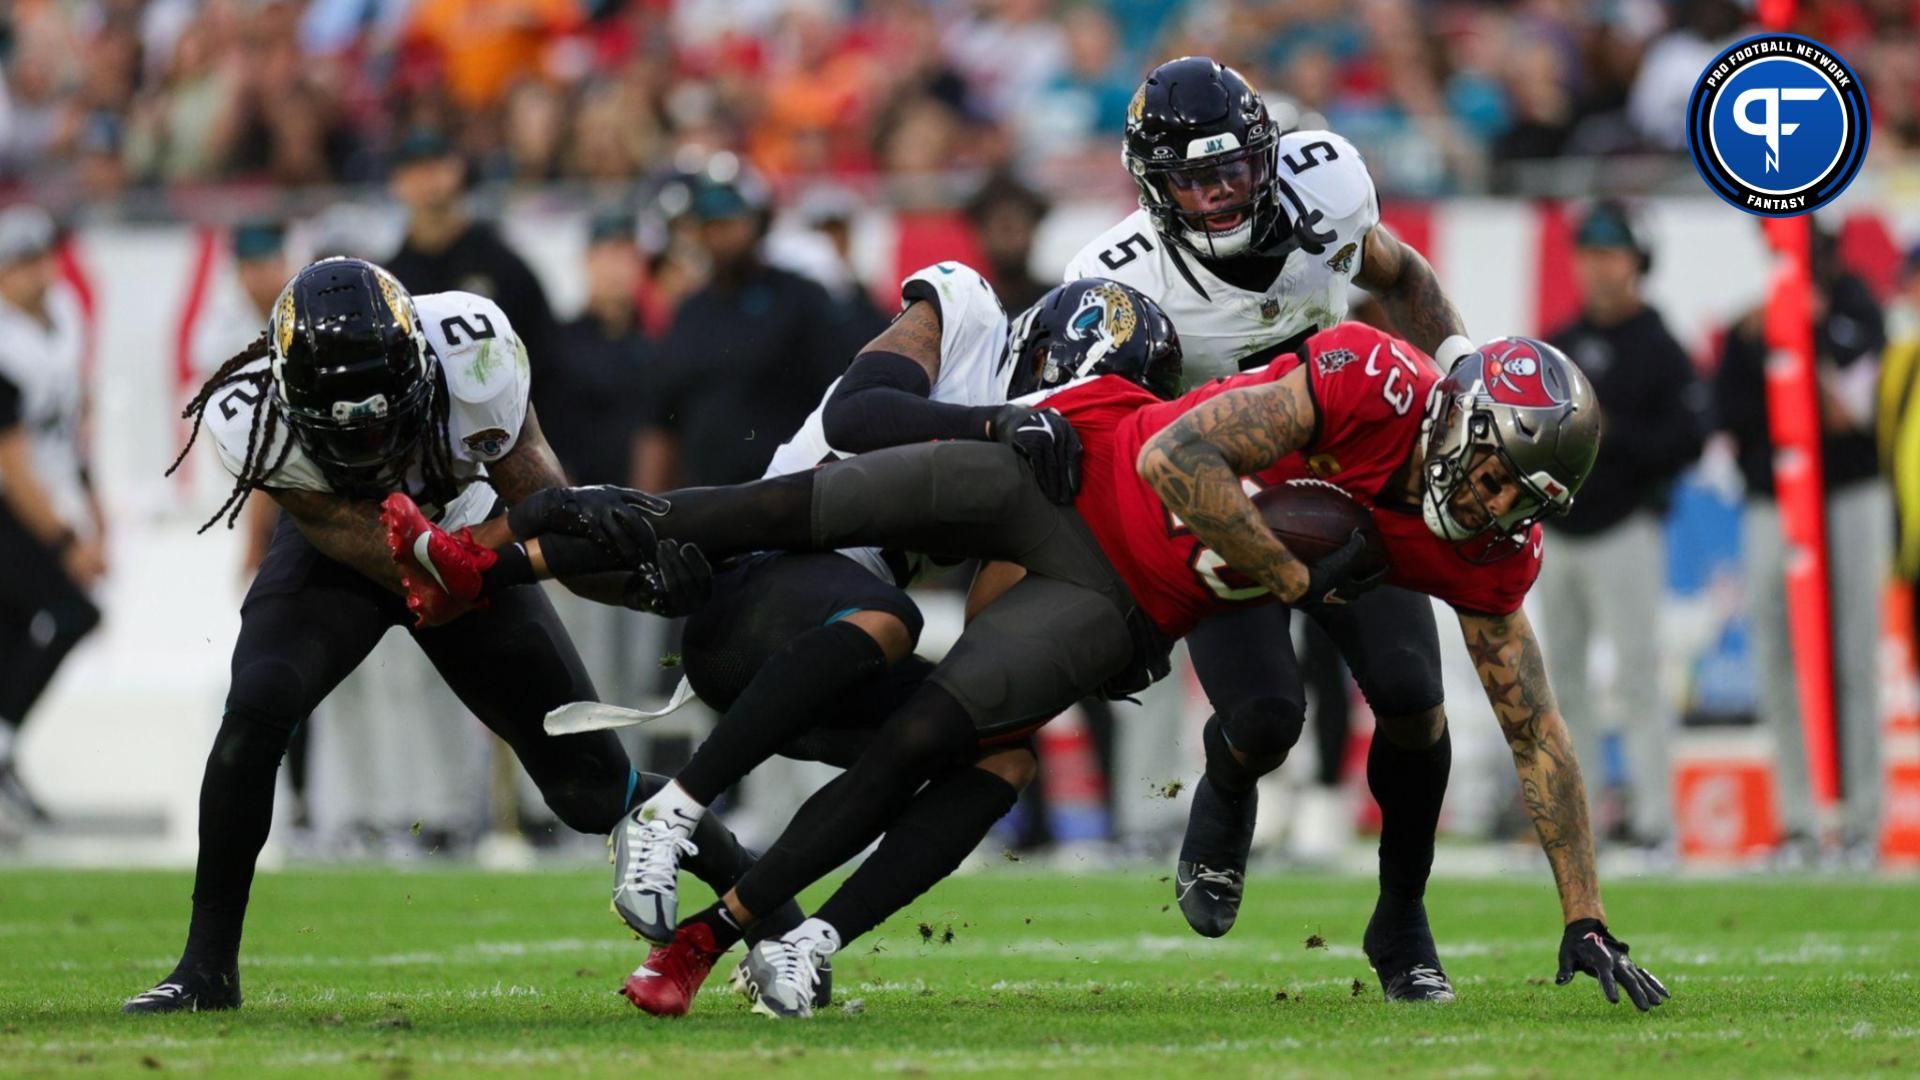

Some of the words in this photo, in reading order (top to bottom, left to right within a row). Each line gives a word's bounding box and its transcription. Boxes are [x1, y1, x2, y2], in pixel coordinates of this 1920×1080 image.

[1204, 138, 1225, 154] JAX
[1281, 140, 1340, 175] 5
[1098, 232, 1155, 271] 5
[440, 312, 497, 346] 2
[1383, 341, 1419, 416] 13
